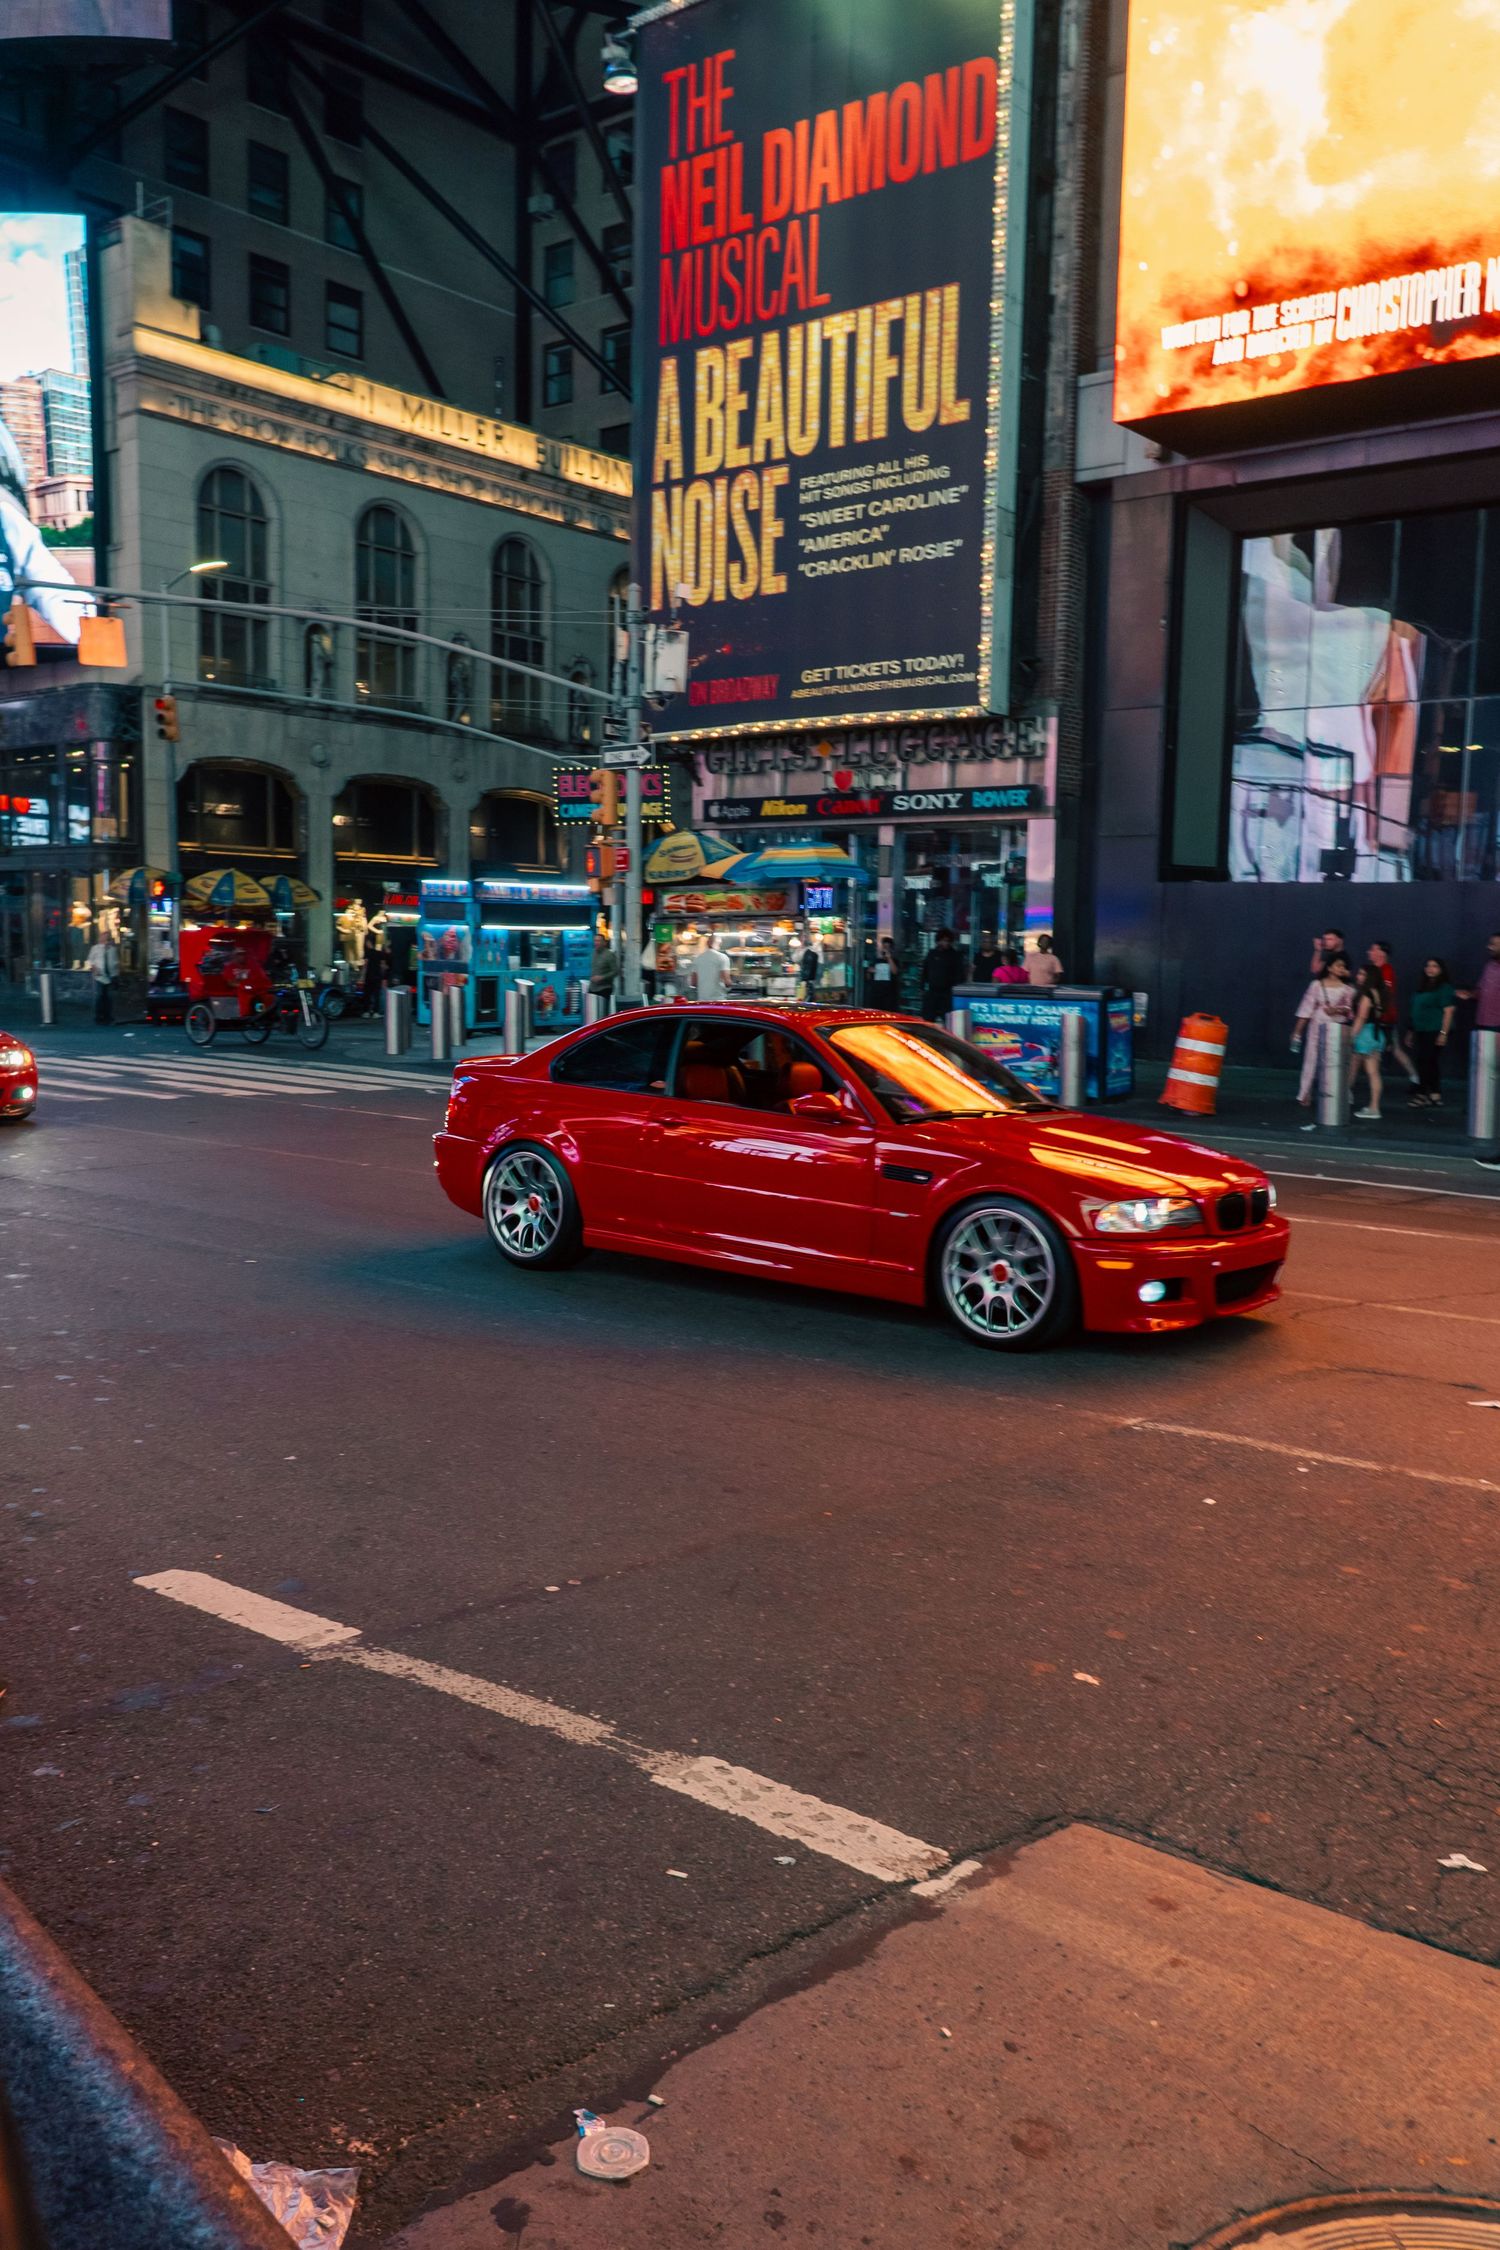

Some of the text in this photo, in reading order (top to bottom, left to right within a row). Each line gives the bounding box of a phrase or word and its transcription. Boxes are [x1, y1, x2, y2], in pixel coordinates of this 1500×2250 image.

[662, 49, 736, 158] THE
[661, 57, 998, 254] NEIL DIAMOND
[659, 214, 831, 346] MUSICAL
[1251, 304, 1280, 332] THE
[1280, 291, 1337, 326] SCREEN
[1335, 261, 1481, 341] CHRISTOPHER
[1313, 318, 1336, 345] BY
[653, 282, 970, 484] A BEAUTIFUL
[175, 394, 219, 426] THE
[303, 430, 369, 467] FOLKS
[377, 451, 427, 483] SHOE
[401, 394, 509, 454] MILLER
[536, 436, 633, 489] BUILDIN
[799, 454, 930, 489] FEATURING ALL HIS
[799, 466, 951, 504] HIT SONGS INCLUDING
[651, 464, 790, 612] NOISE
[710, 674, 780, 704] BROADWAY
[790, 672, 976, 699] ABEAUTIFULNOISETHEMUSICAL.COM
[801, 653, 965, 684] GET TICKETS TODAY!
[705, 717, 1046, 774] GIFTS LUGGAGE
[720, 789, 1031, 818] Apple Nikon Canon SONY BOWER
[974, 1013, 1030, 1024] ROADWAY
[991, 1003, 1015, 1014] TIME
[1017, 1004, 1033, 1014] TO
[1035, 1005, 1082, 1018] CHANGE
